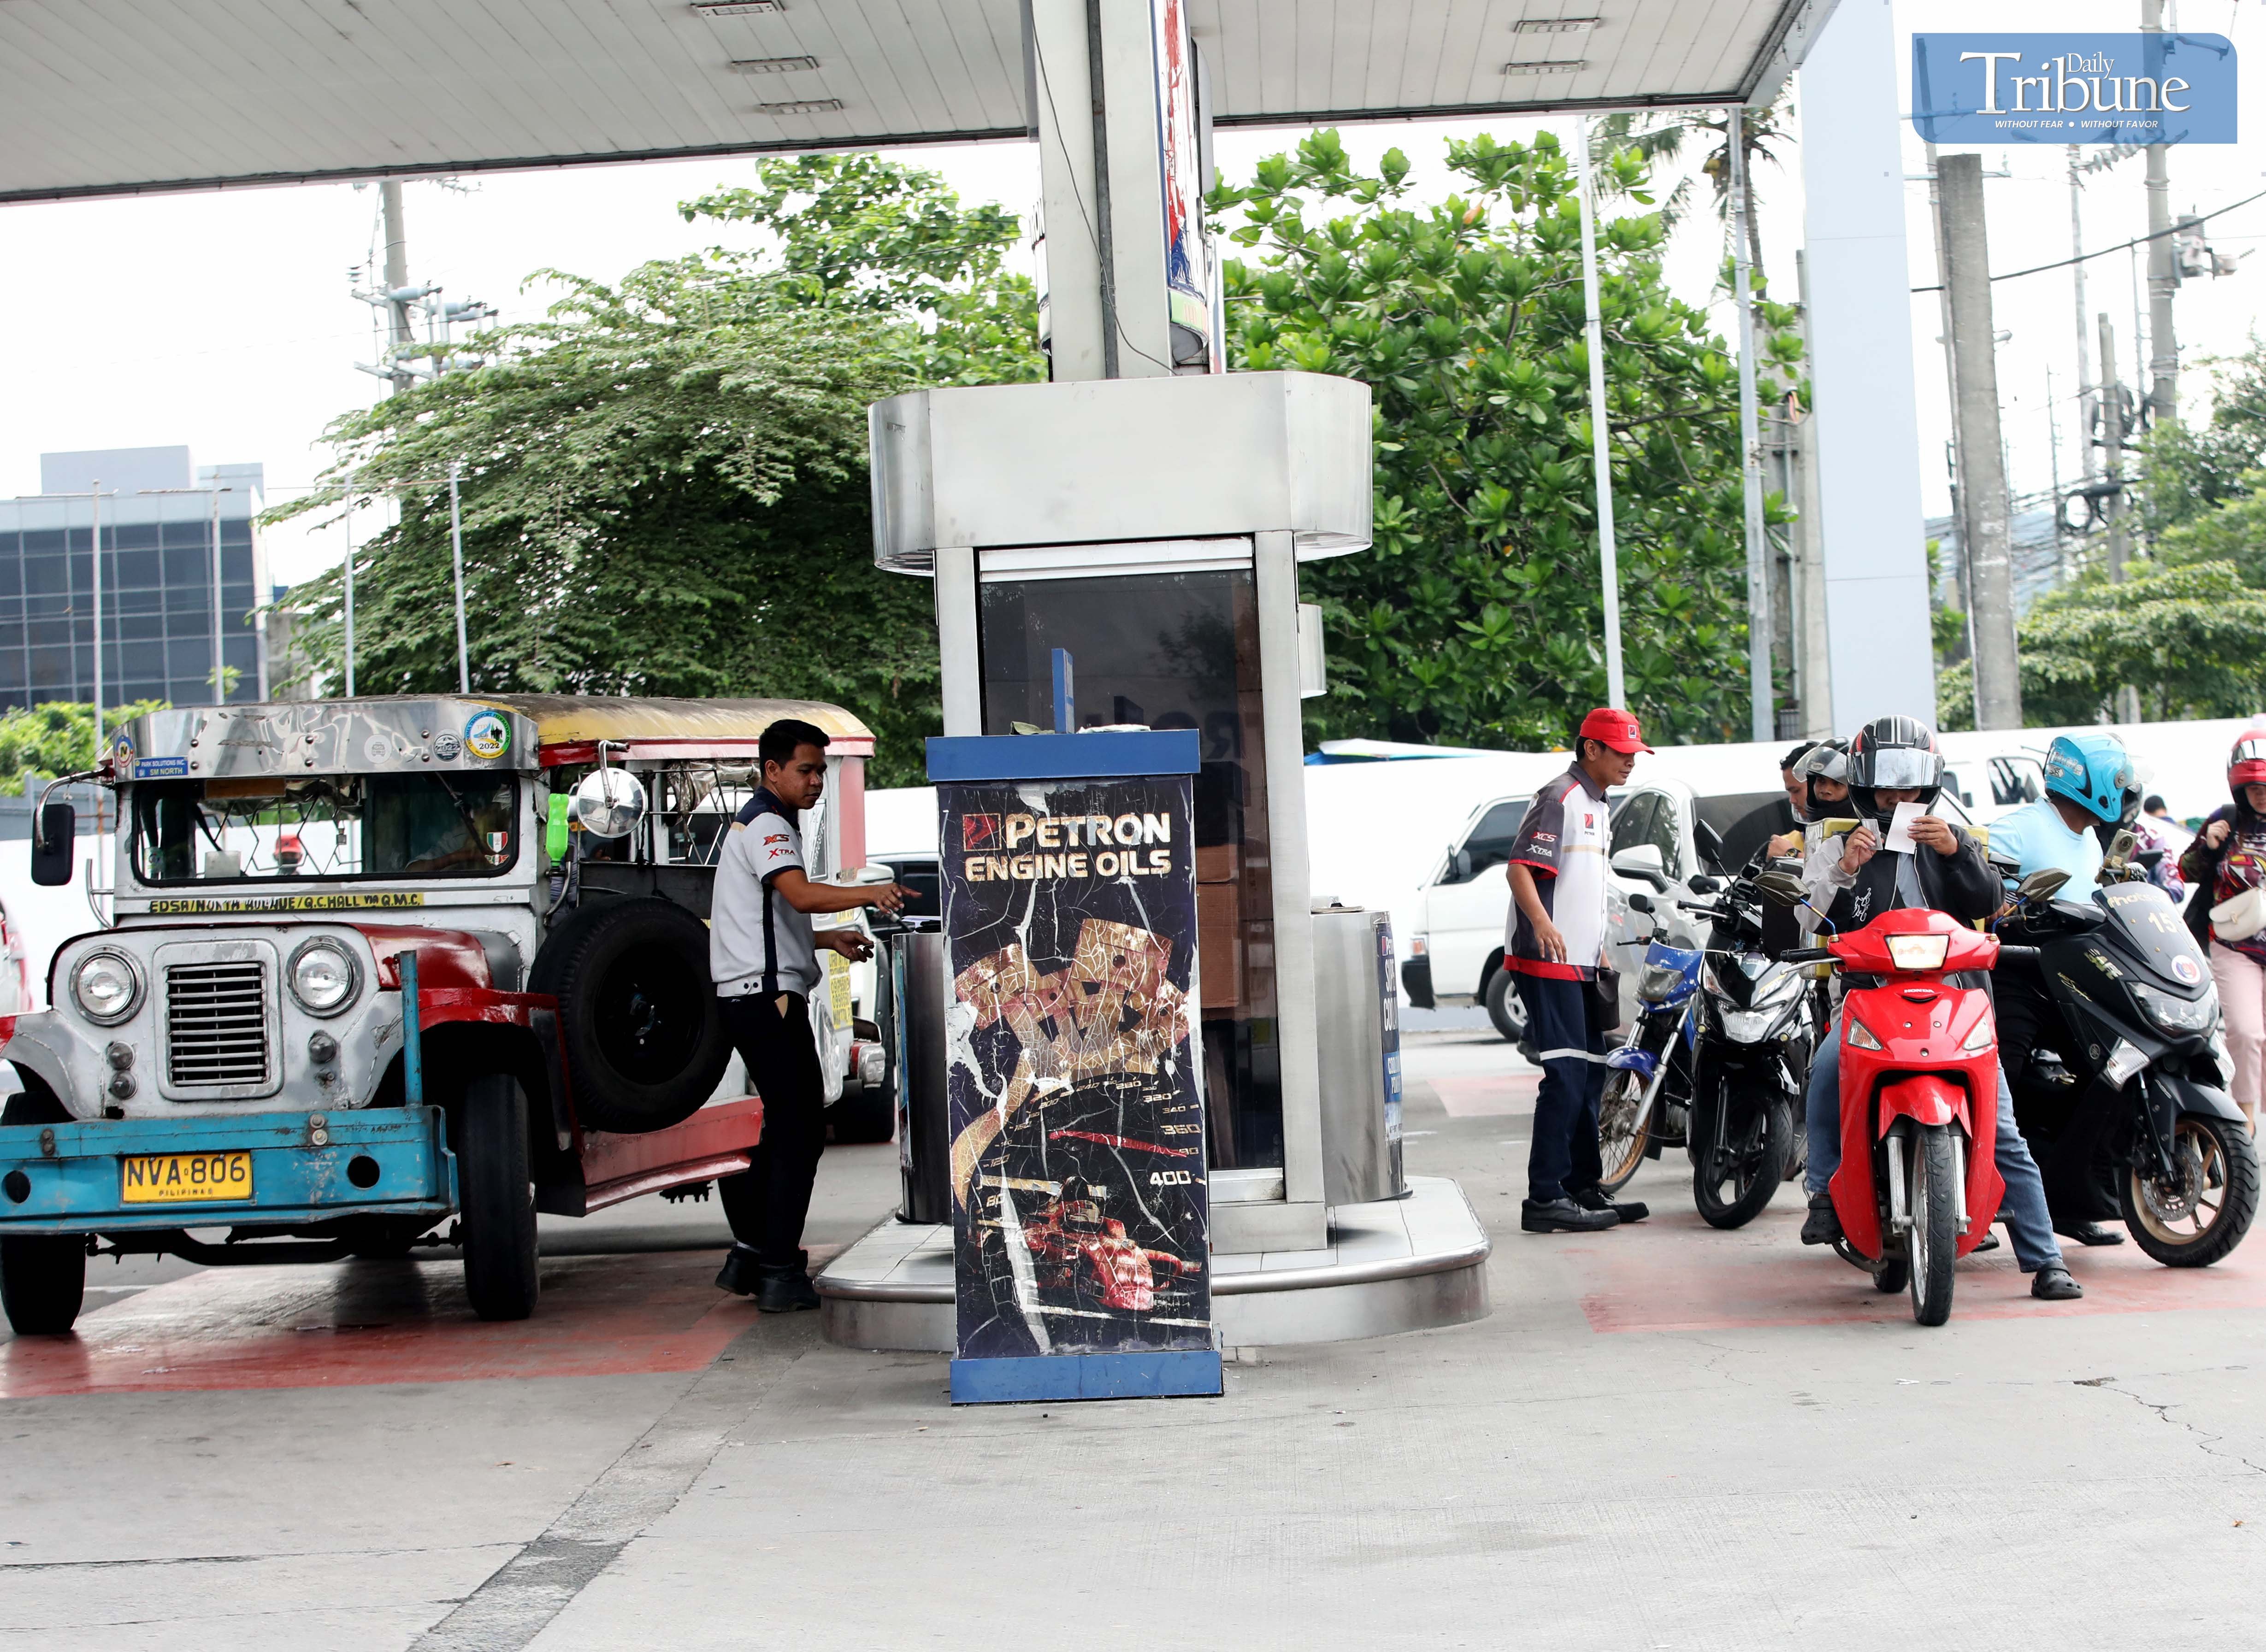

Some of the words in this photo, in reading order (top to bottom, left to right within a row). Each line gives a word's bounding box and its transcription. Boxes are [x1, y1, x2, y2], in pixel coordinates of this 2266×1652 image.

[1005, 812, 1171, 849] PETRON
[763, 834, 790, 847] XCS
[1533, 832, 1557, 842] XCS
[767, 848, 796, 860] XTRA
[1526, 844, 1552, 857] XTRA
[965, 852, 1088, 882] ENGINE
[1096, 849, 1172, 876] OILS
[2148, 912, 2178, 934] 15
[1116, 1080, 1142, 1090] 280
[1038, 1098, 1060, 1110] 200
[1143, 1093, 1172, 1103] 320
[1162, 1105, 1186, 1114] 340
[1160, 1123, 1202, 1135] 360
[128, 1157, 181, 1187] NVA
[191, 1155, 246, 1184] 806
[1150, 1170, 1192, 1187] 400
[159, 1188, 213, 1196] PILIPINAS
